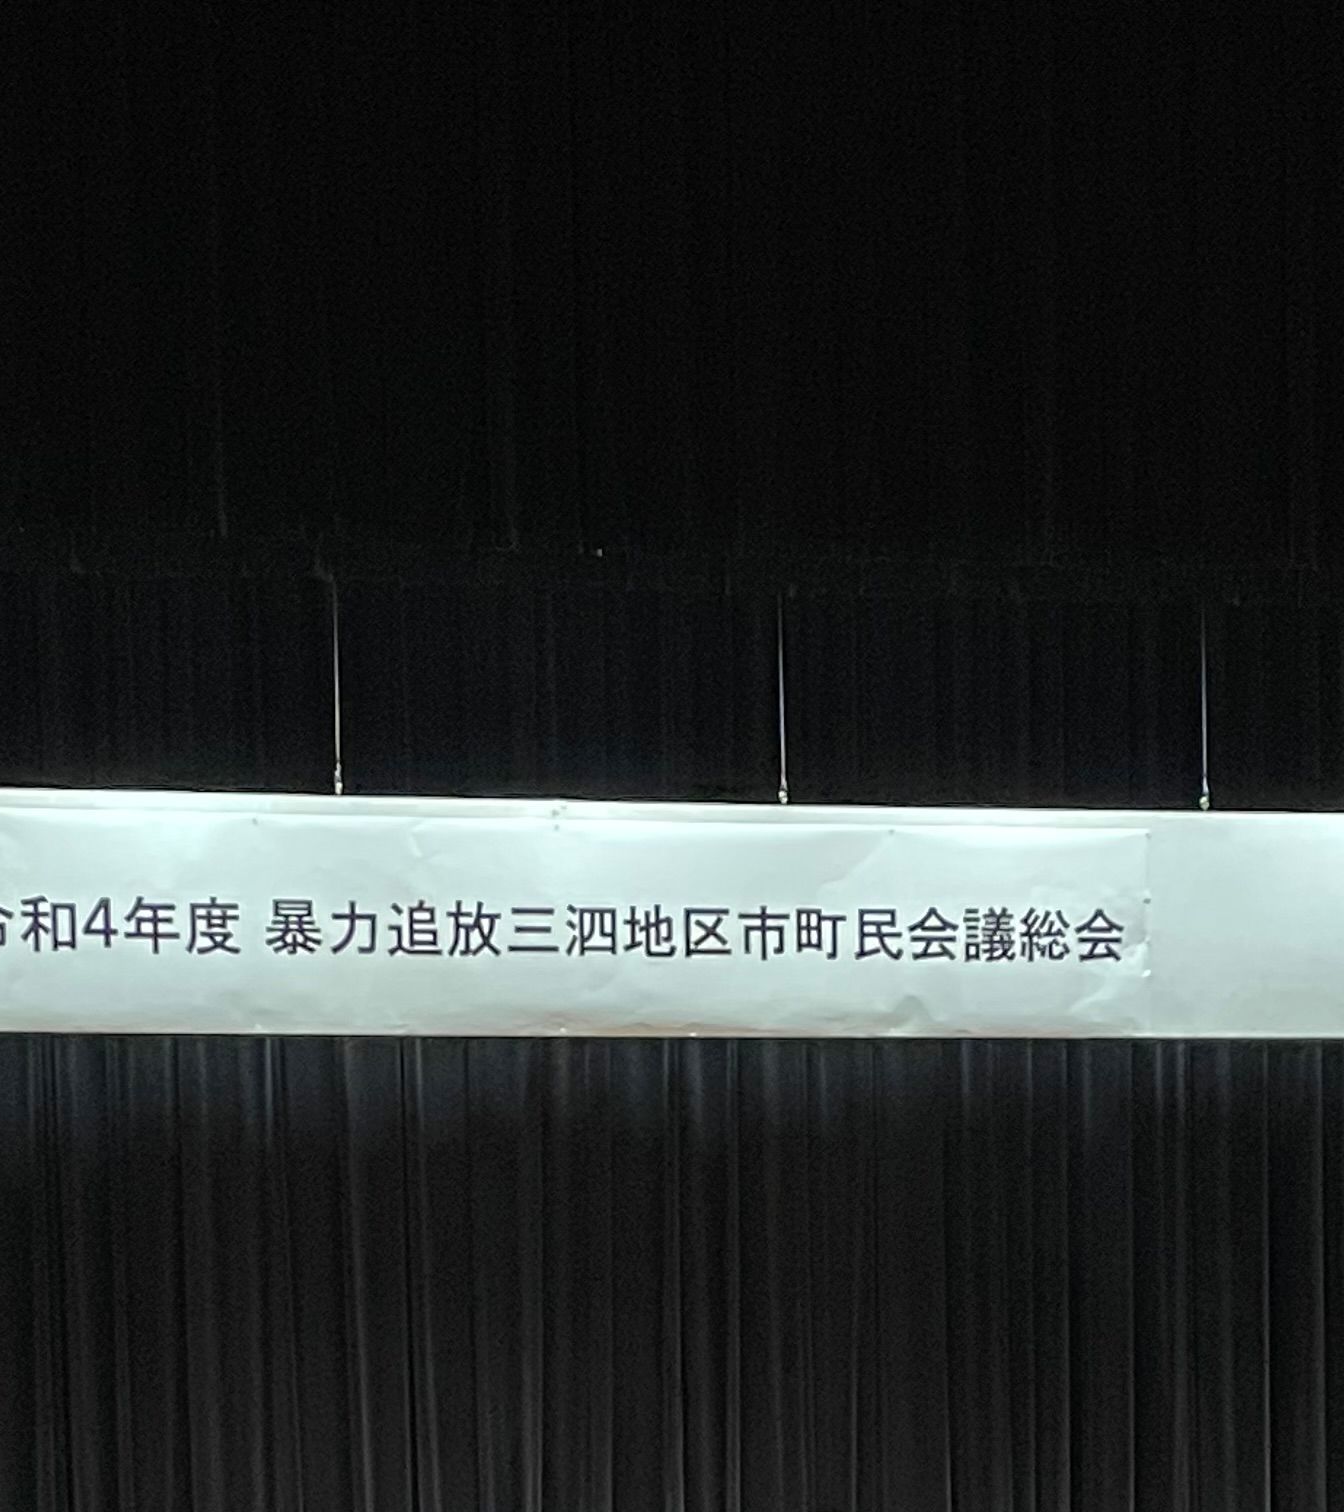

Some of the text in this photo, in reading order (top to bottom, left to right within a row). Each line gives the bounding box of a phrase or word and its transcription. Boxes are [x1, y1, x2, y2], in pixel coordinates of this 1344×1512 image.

[264, 897, 1126, 963] 暴力追放三泗地区市町民会議総会
